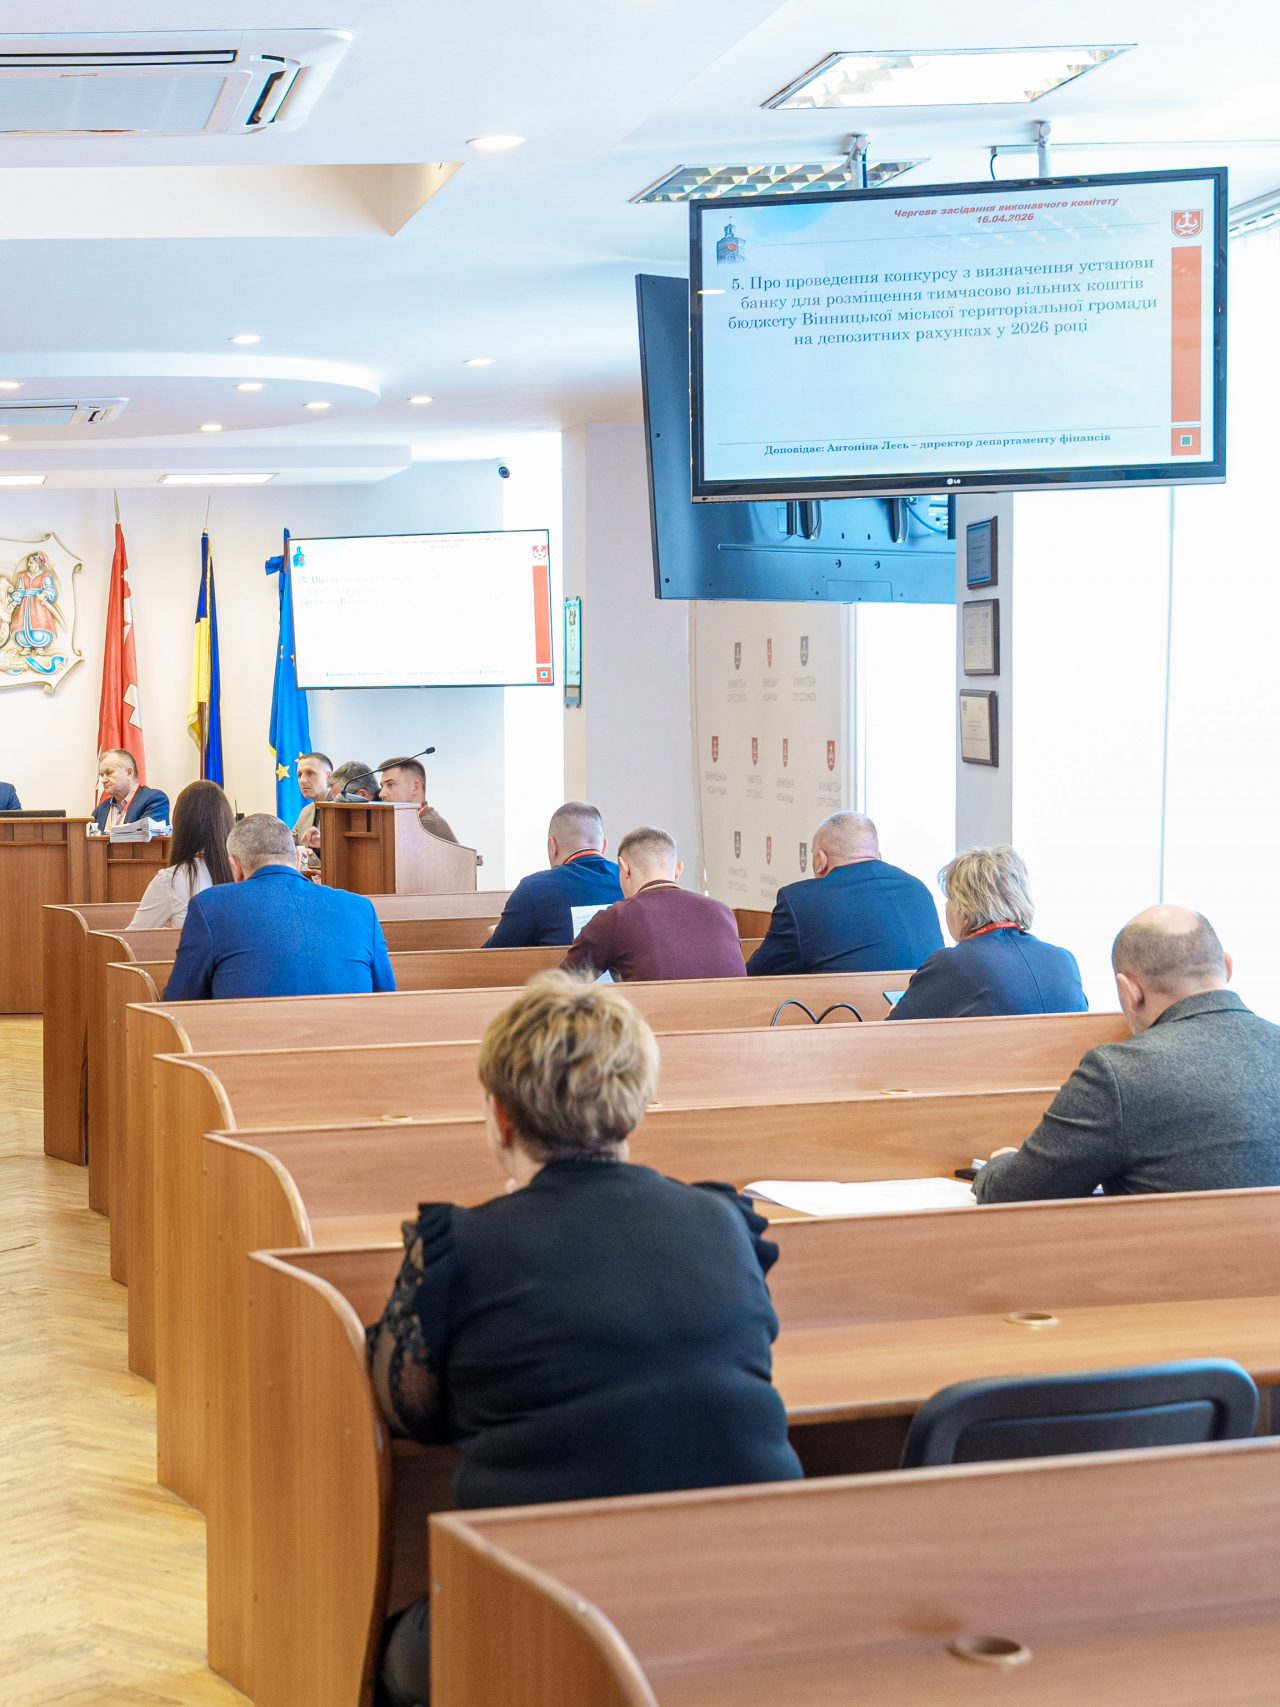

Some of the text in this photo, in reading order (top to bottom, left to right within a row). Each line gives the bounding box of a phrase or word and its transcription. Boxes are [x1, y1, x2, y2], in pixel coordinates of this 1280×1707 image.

[894, 197, 1119, 218] Чергове засідання виконавчого комітету
[976, 213, 1035, 224] 16.04.2026
[731, 259, 1154, 291] 5. Про проведення конкурсу з визначення установи
[741, 276, 1144, 310] банку для розміщення тимчасово вільних коштів
[728, 298, 1158, 329] бюджету Вінницької міської територіальної громади
[794, 318, 1088, 345] на депозитних рахунках у 2026 році
[826, 443, 878, 453] Антоніна
[881, 441, 909, 449] Лесь
[919, 440, 973, 450] директор
[975, 437, 1056, 448] департаменту
[1060, 433, 1111, 445] фінансів
